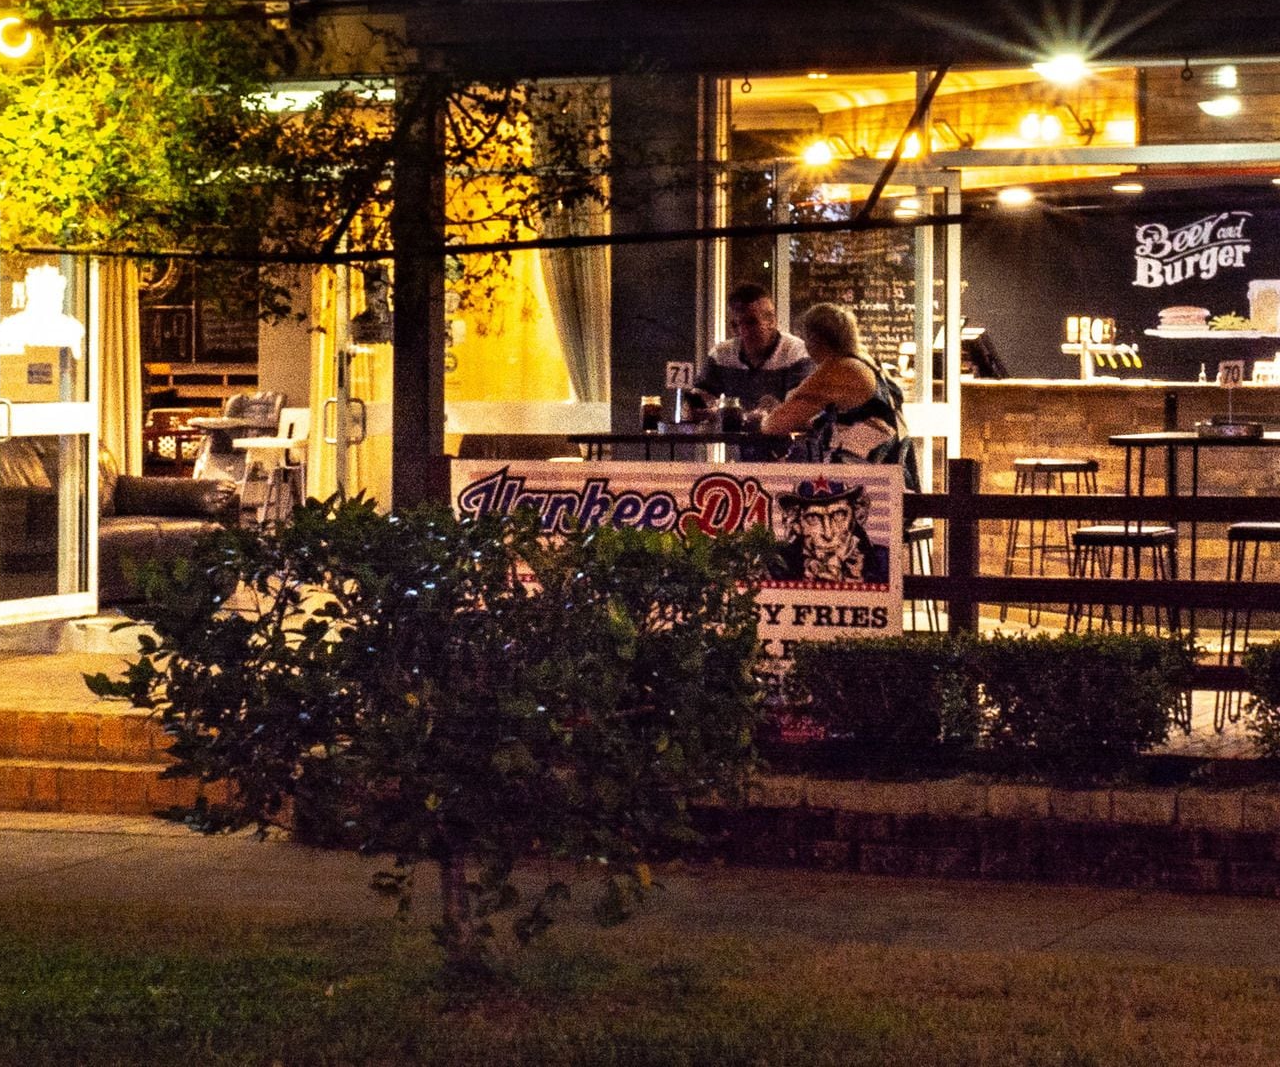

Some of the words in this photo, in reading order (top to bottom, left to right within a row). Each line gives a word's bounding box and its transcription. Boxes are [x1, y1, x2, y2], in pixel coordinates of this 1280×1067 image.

[1135, 212, 1229, 258] Beer
[1217, 217, 1247, 240] and
[1131, 243, 1252, 288] Burger
[669, 365, 690, 384] 71
[1223, 364, 1241, 384] 70
[675, 471, 774, 539] D's
[792, 603, 889, 629] FRIES
